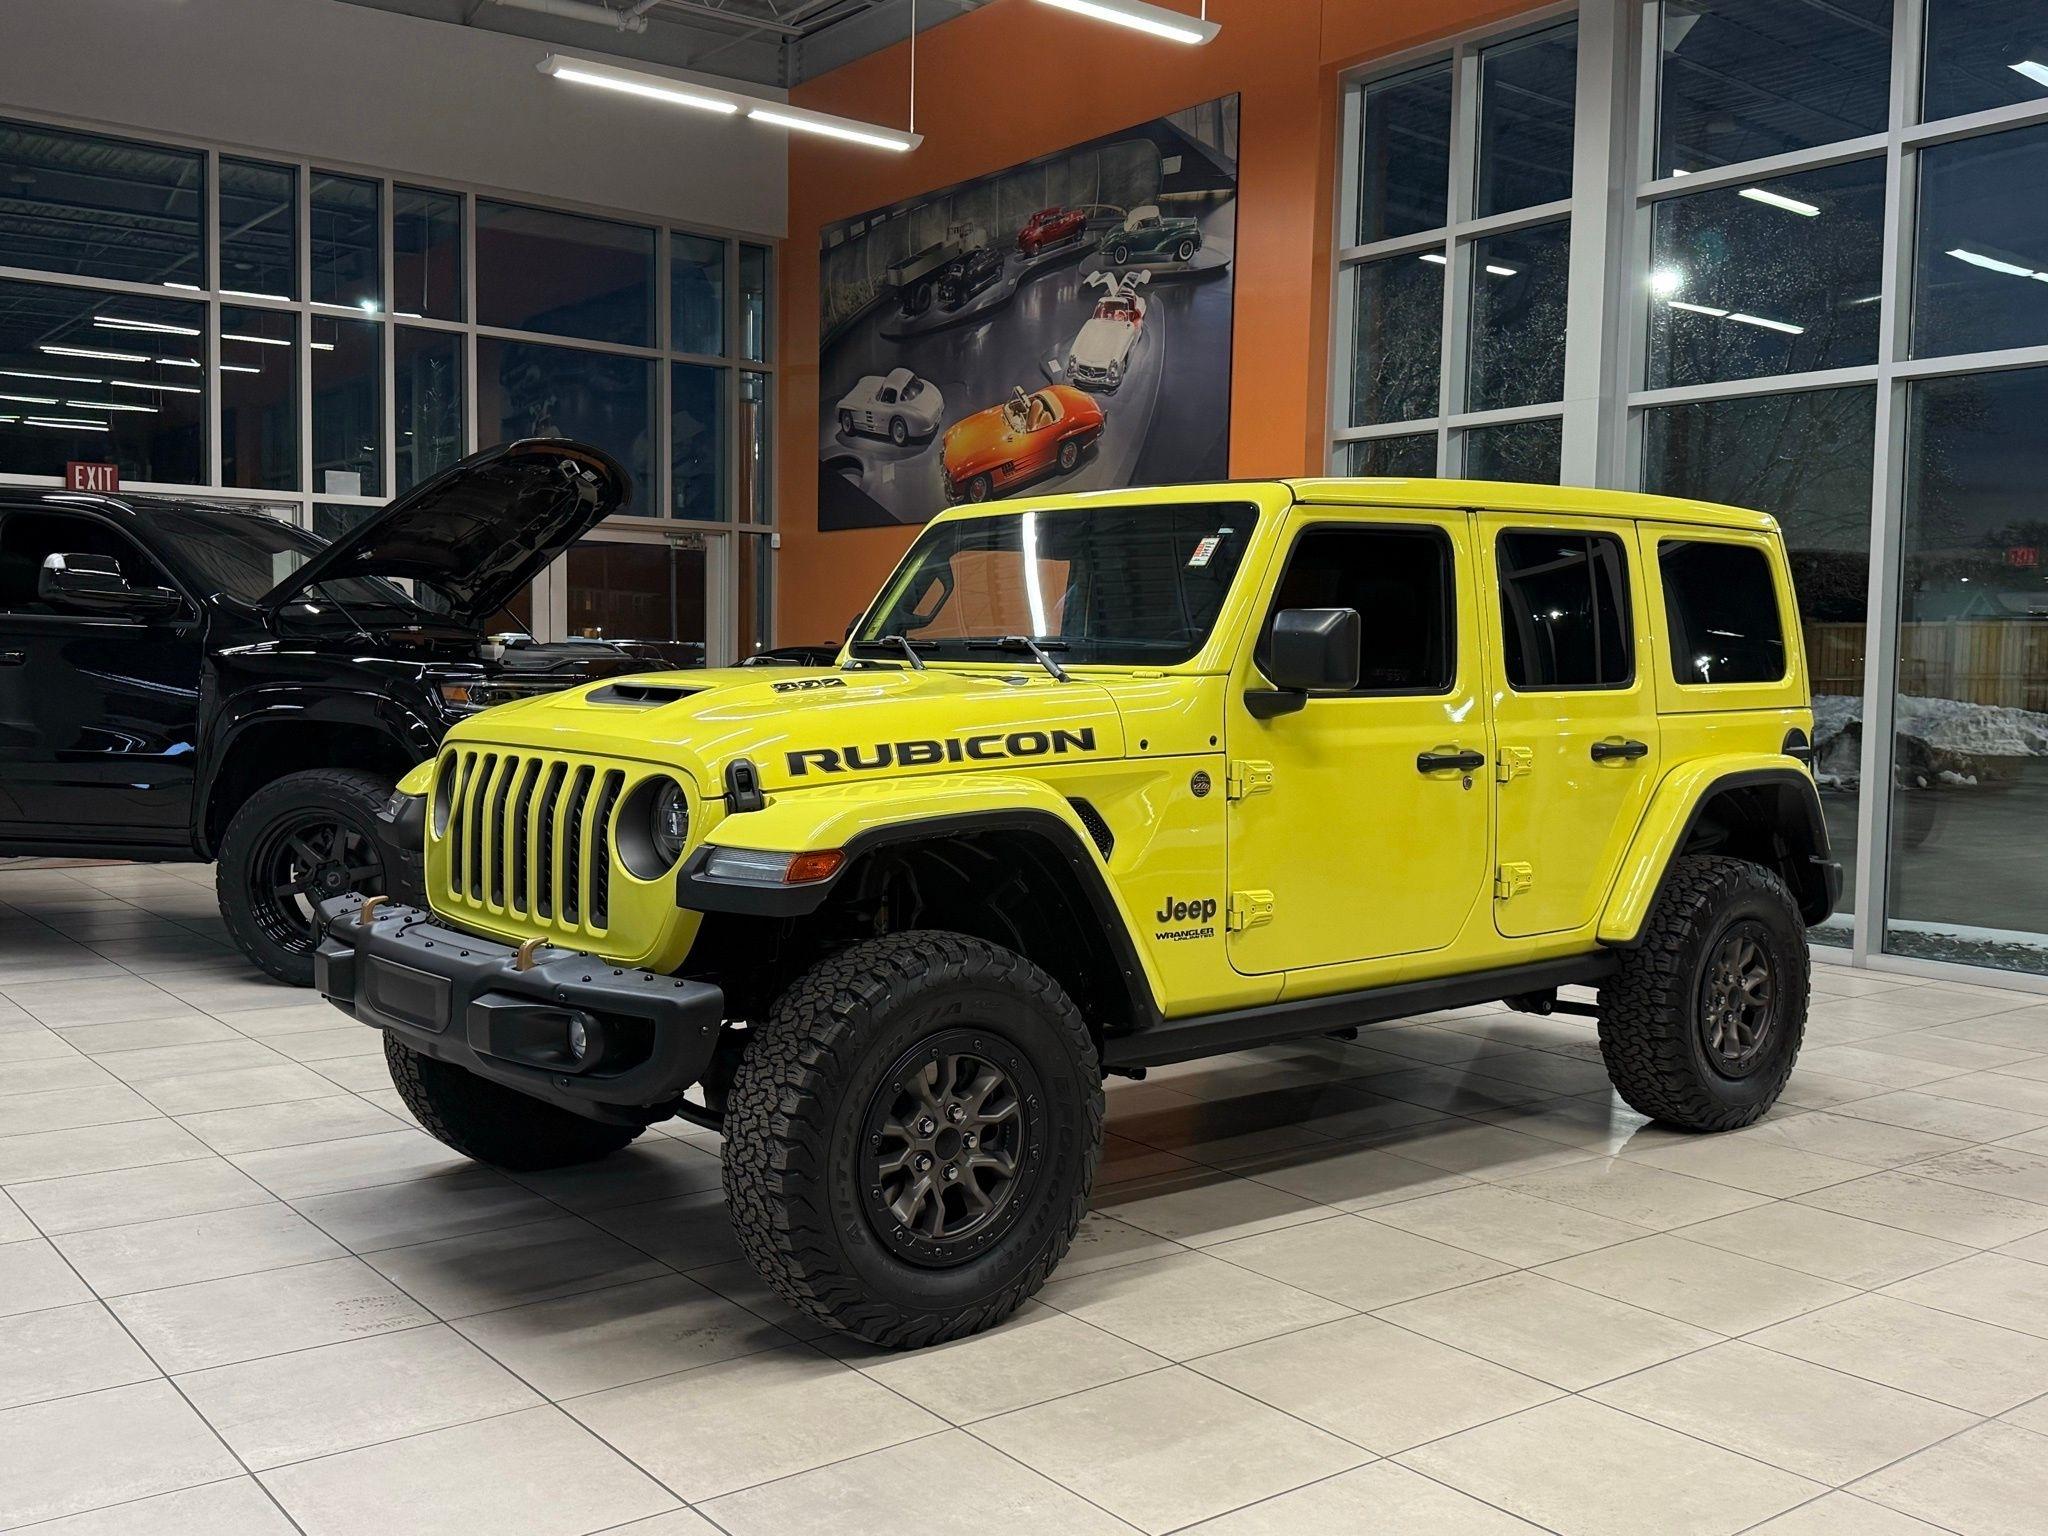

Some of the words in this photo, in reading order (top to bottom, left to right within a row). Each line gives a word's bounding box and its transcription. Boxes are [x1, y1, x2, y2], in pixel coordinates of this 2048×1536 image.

[75, 465, 113, 491] EXIT
[784, 727, 1097, 777] RUBICON
[1156, 896, 1217, 924] Jeep
[1155, 927, 1214, 940] WRANGLER
